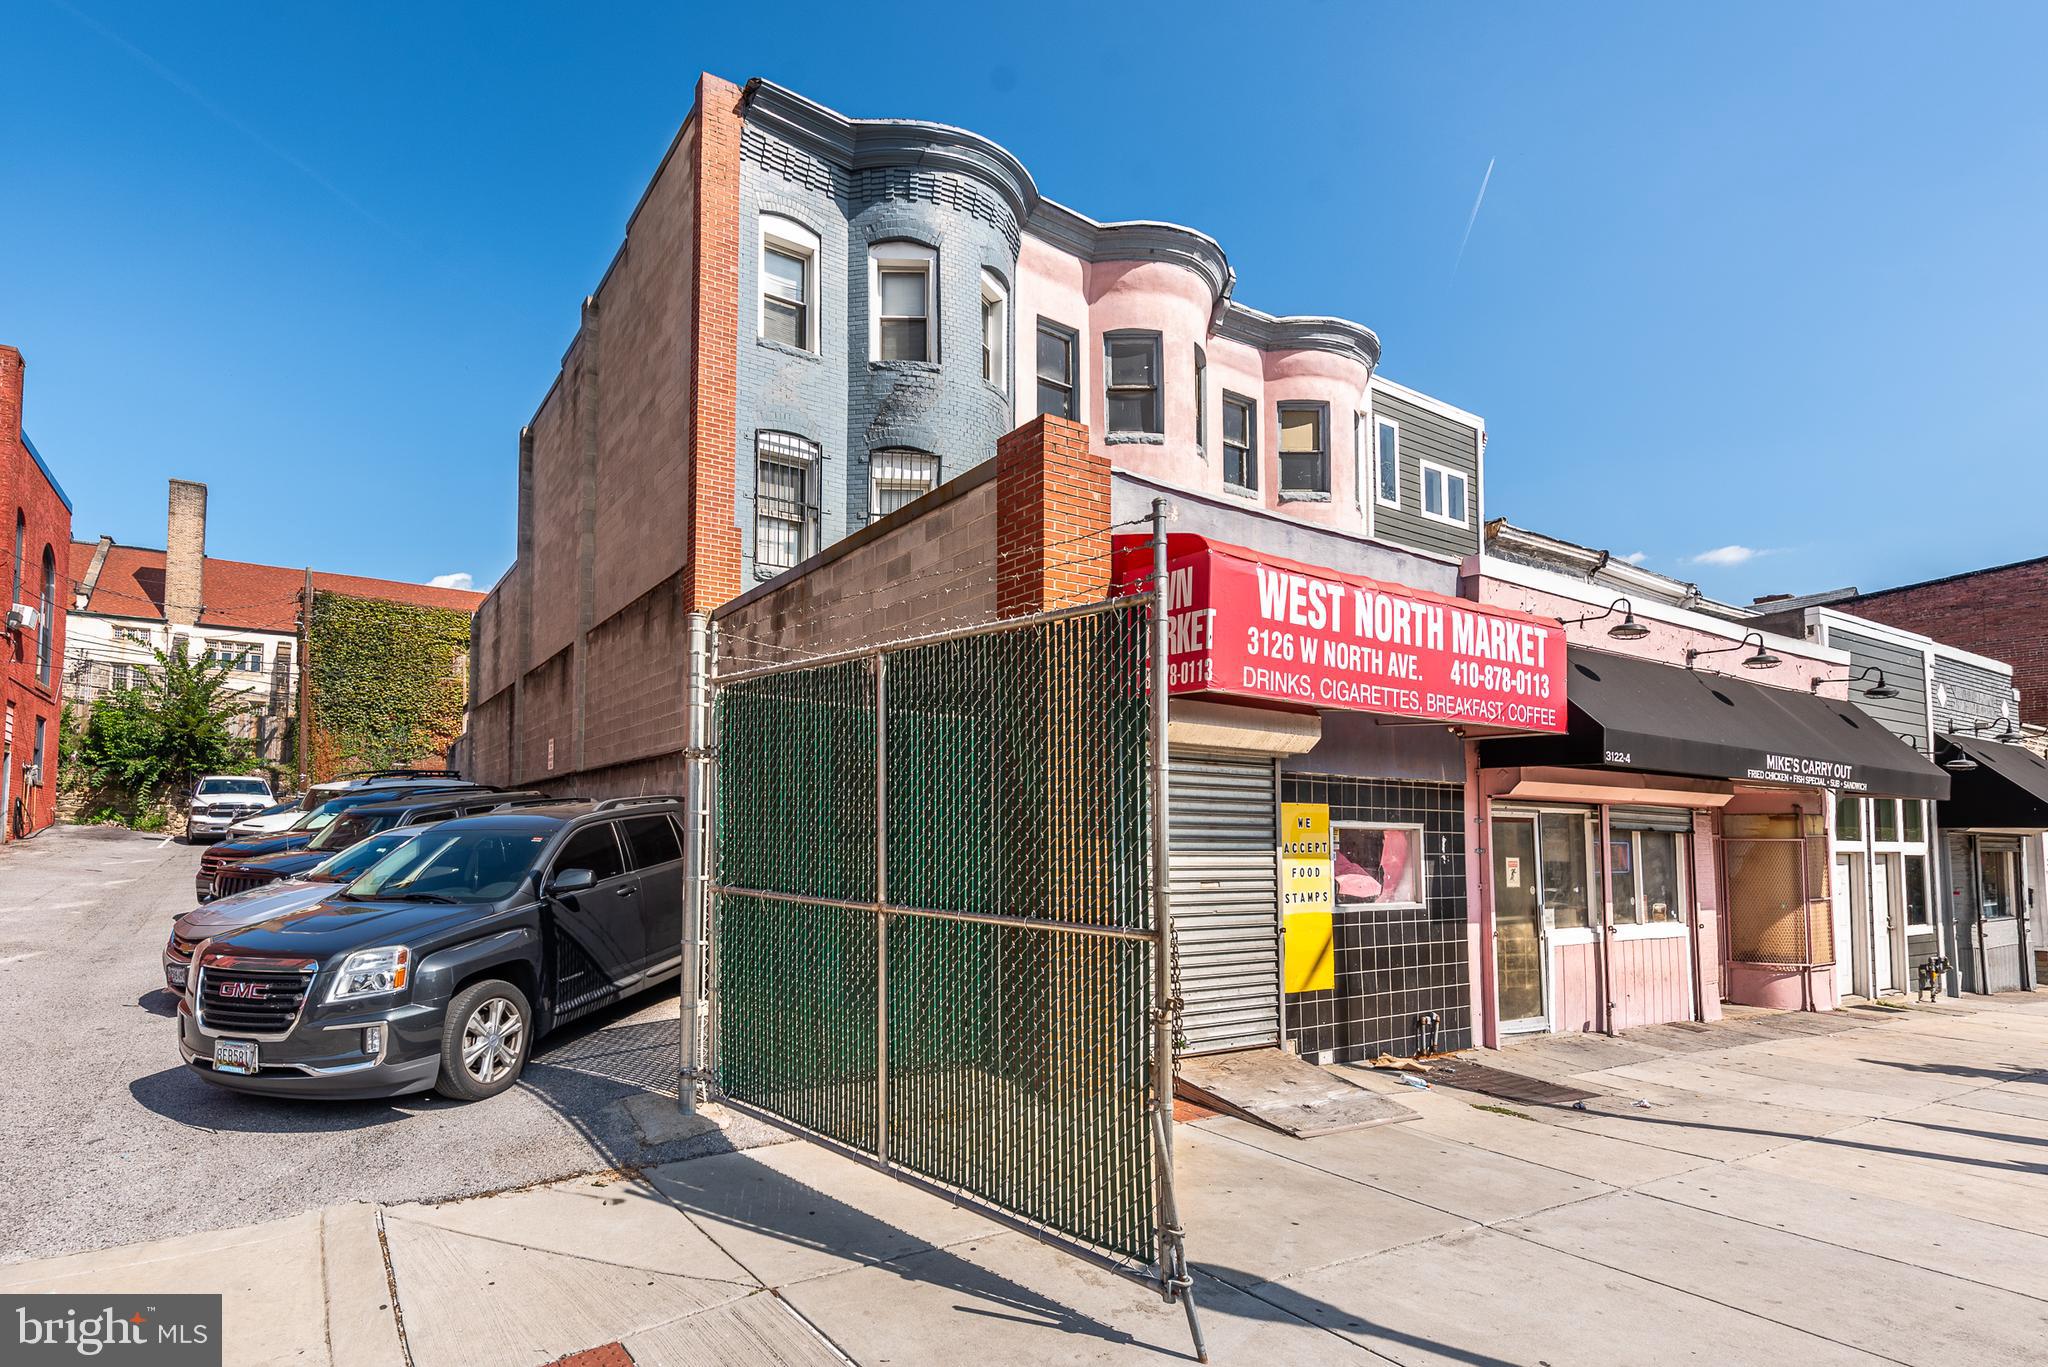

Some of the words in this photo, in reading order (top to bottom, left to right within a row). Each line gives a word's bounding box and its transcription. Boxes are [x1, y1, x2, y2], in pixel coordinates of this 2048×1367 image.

[1256, 568, 1345, 632] WEST
[1354, 590, 1443, 650] NORTH
[1451, 610, 1548, 668] MARKET
[1167, 608, 1216, 655] RKET
[1247, 626, 1294, 662] 3126
[1300, 636, 1318, 664] W
[1323, 640, 1383, 675] NORTH
[1387, 652, 1423, 681] AVE.
[1450, 660, 1550, 699] 410-878-0113
[1243, 666, 1315, 700] DRINKS,
[1320, 677, 1423, 713] CIGARETTES,
[1426, 693, 1505, 722] BREAKFAST,
[1508, 703, 1557, 726] COFFEE
[1605, 750, 1631, 763] 3122-4
[1766, 754, 1800, 773] MIKE'S
[1801, 759, 1833, 777] CARRY
[1834, 763, 1852, 779] OUT
[1747, 769, 1764, 779] FRIED
[1764, 771, 1789, 782] CHICKEN
[1793, 774, 1806, 784] FISH
[1806, 776, 1827, 786] SPECIAL
[1830, 779, 1840, 788] SUB
[1843, 781, 1867, 791] SANDWICH
[1297, 817, 1311, 828] WE
[1284, 842, 1327, 853] ACCEPT
[1292, 867, 1320, 878] FOOD
[1285, 892, 1328, 904] STAMPS
[219, 982, 267, 999] GMC
